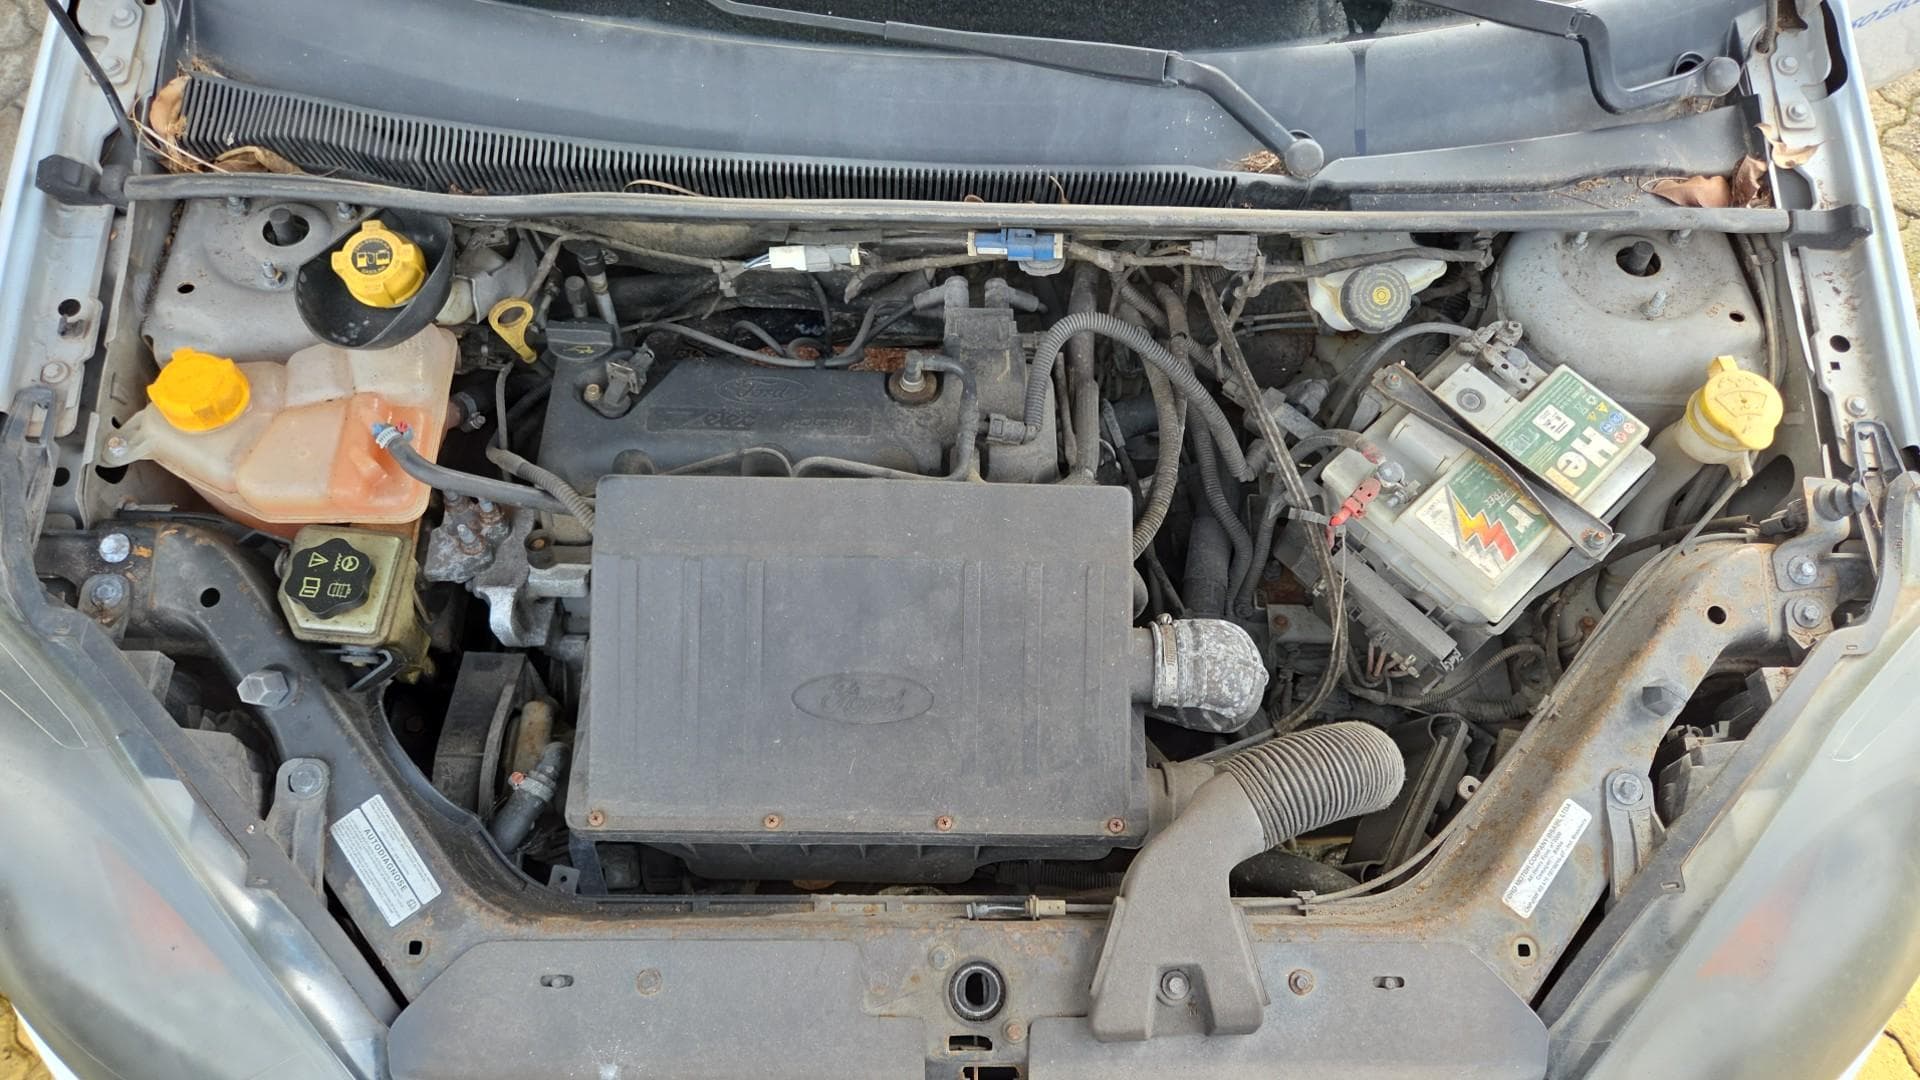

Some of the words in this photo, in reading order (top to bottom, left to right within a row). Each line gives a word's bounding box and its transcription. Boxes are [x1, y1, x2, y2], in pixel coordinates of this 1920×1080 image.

[363, 827, 408, 892] AUTODIAGNOSE
[1514, 864, 1531, 886] MOTOR
[1527, 836, 1549, 866] COMPANY
